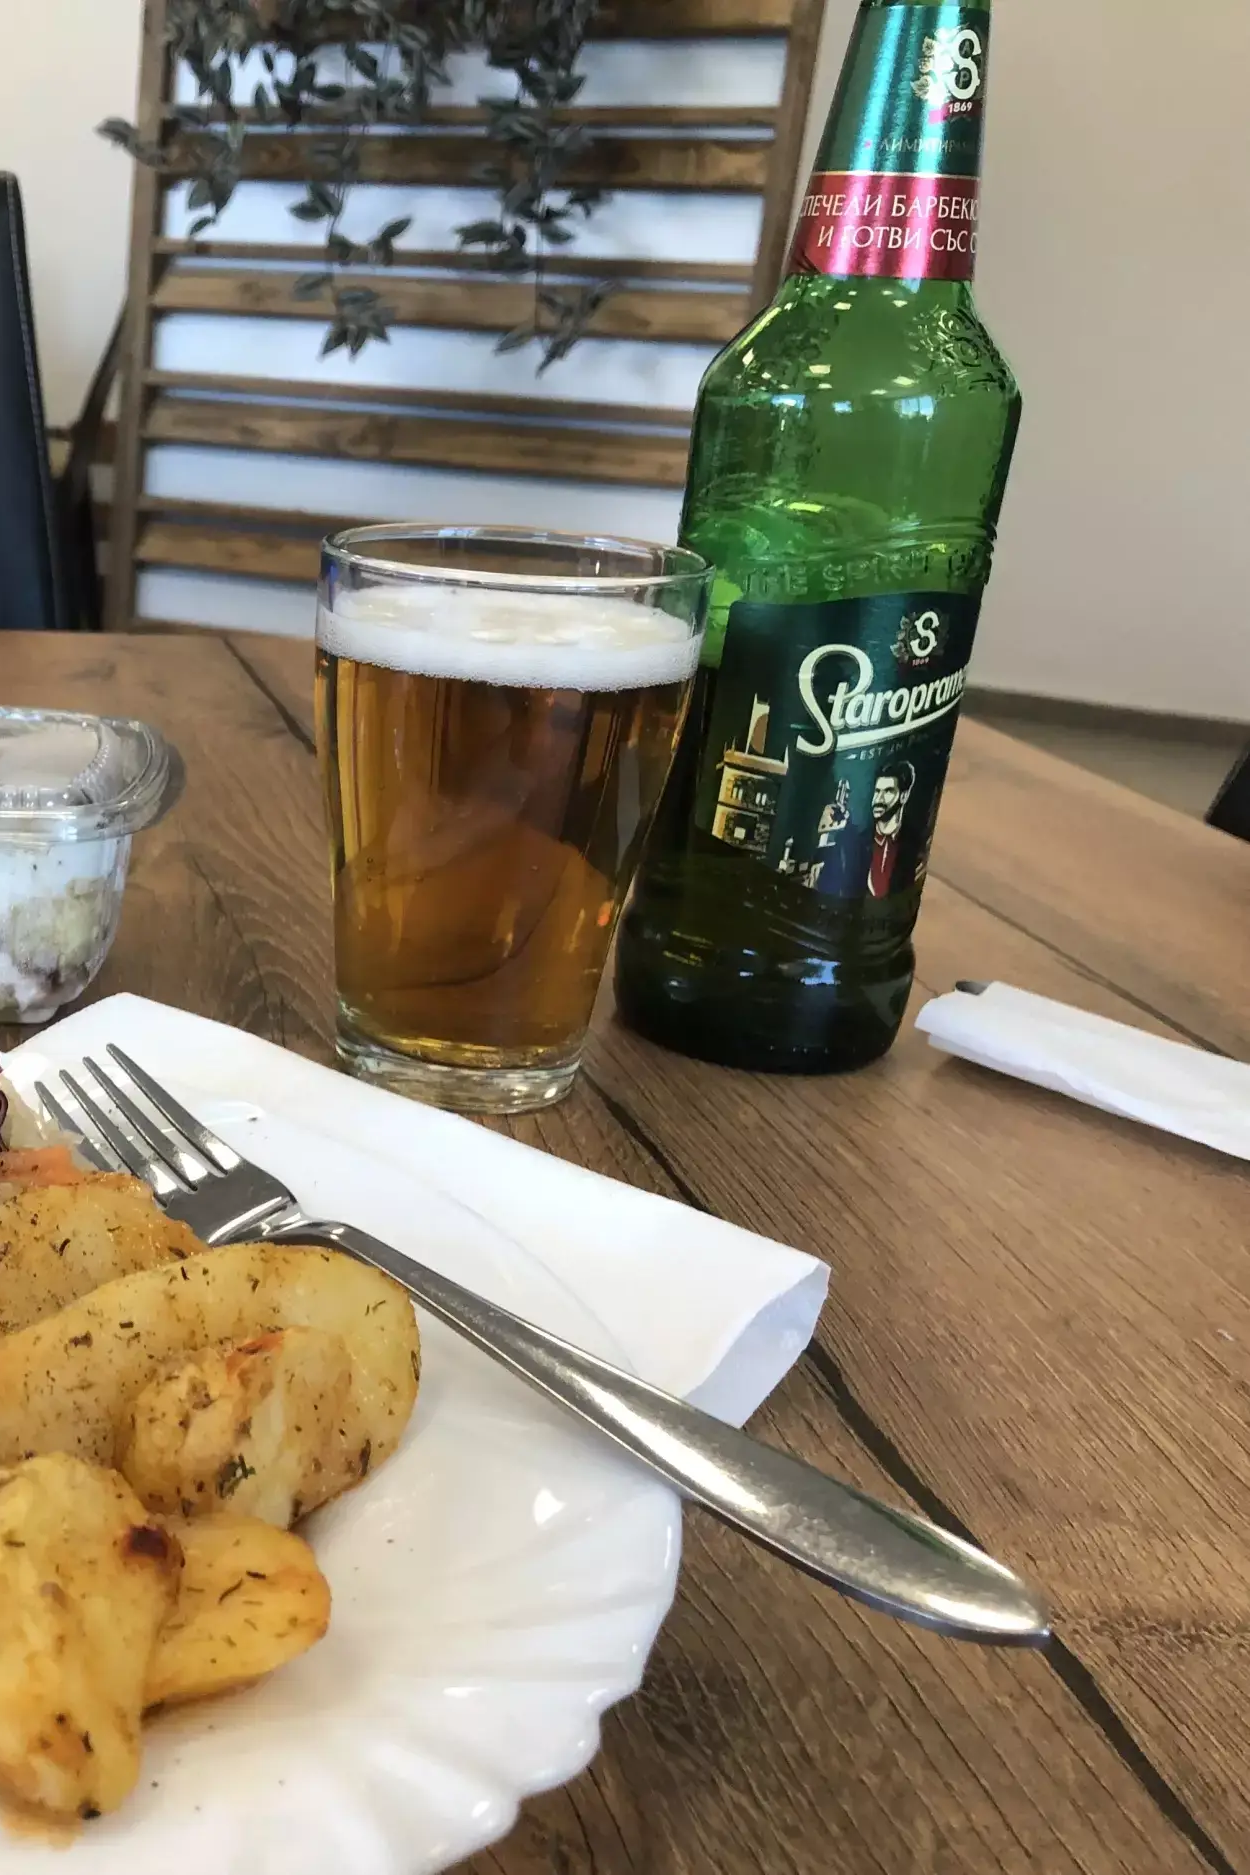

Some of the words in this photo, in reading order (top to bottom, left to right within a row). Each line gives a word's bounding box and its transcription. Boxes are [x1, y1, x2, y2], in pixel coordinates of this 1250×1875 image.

[948, 101, 972, 113] 1869
[801, 194, 882, 218] ПЕЧЕЛИ
[817, 225, 834, 248] И
[840, 225, 922, 250] ГОТВИ
[930, 228, 968, 253] СЪС
